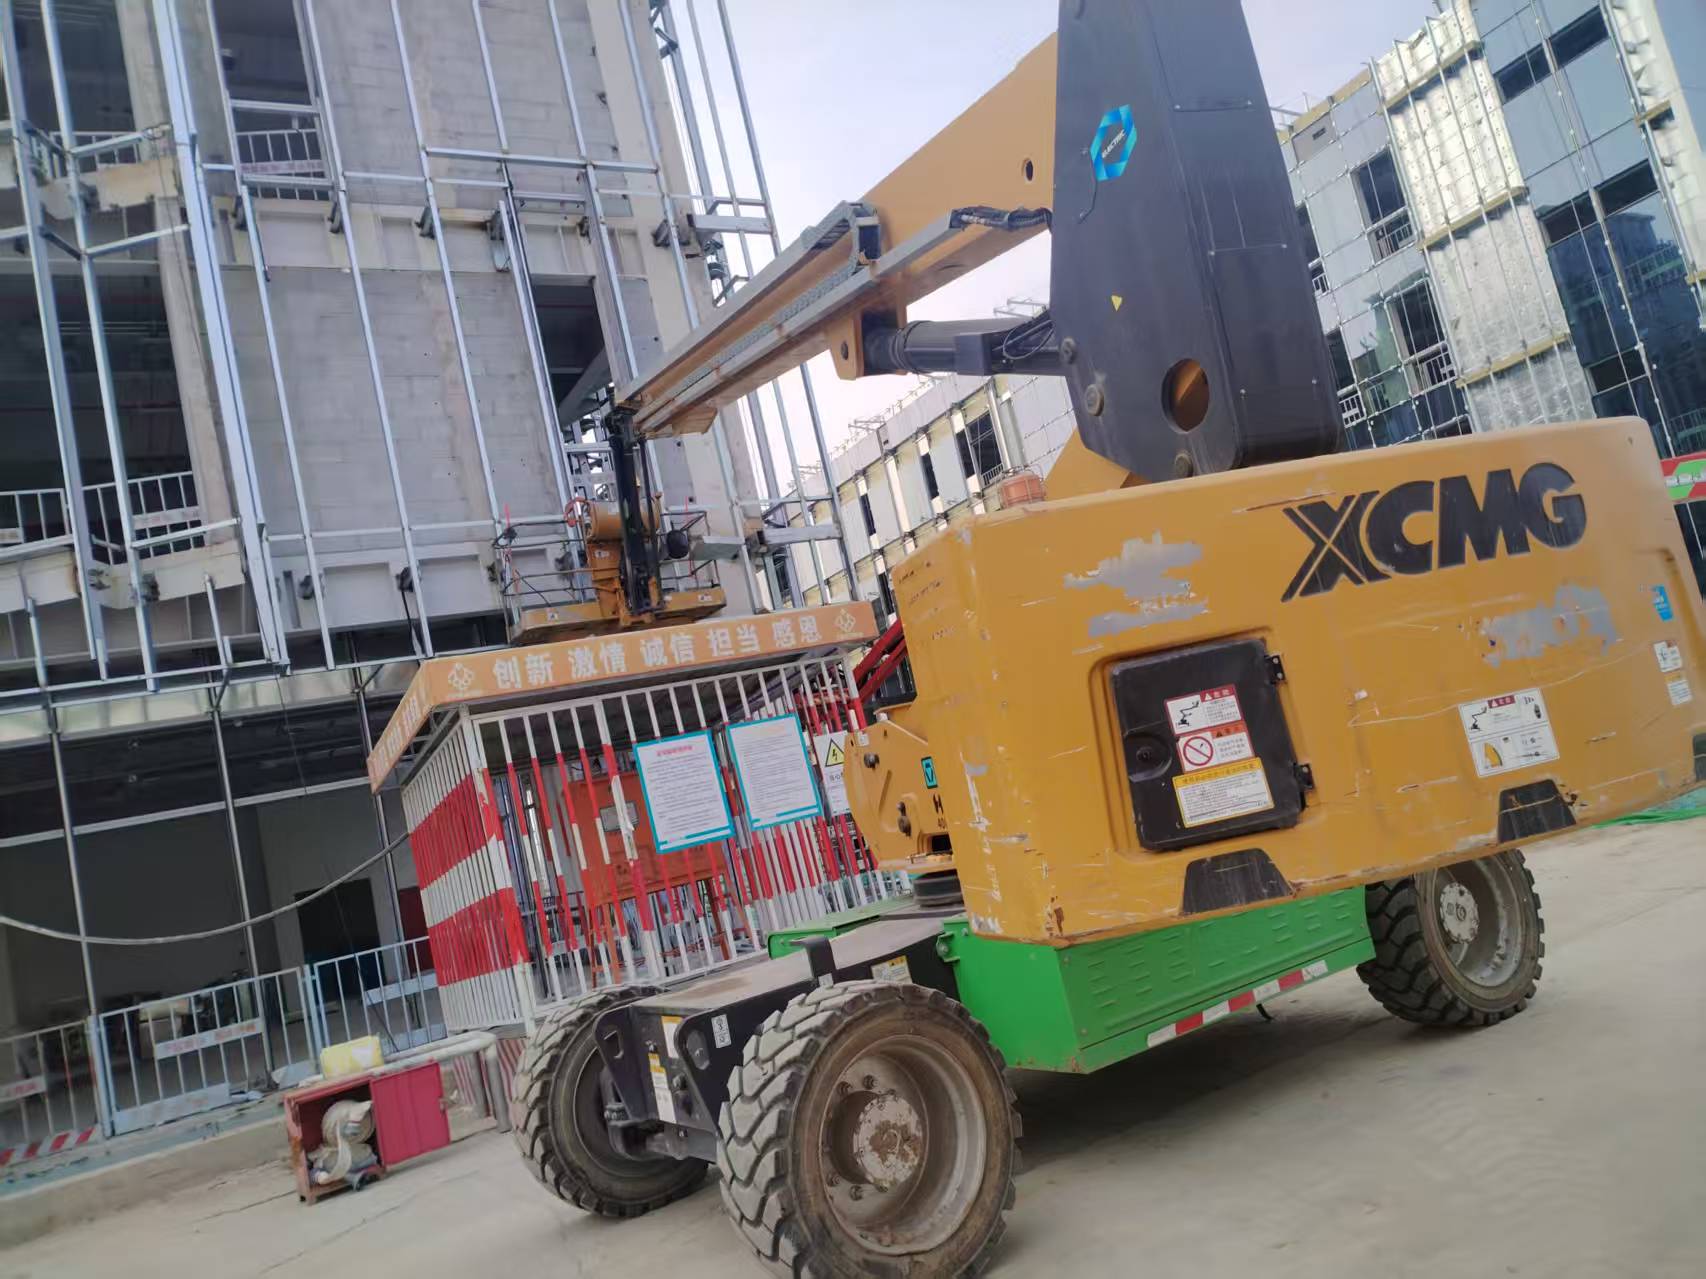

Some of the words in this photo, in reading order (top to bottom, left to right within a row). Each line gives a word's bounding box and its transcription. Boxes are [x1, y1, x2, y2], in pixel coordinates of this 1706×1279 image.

[1280, 463, 1587, 603] XCMG
[492, 652, 556, 690] 创新
[567, 643, 629, 678] 激情
[640, 635, 698, 668] 诚信
[708, 624, 762, 659] 担当
[772, 615, 822, 649] 感恩
